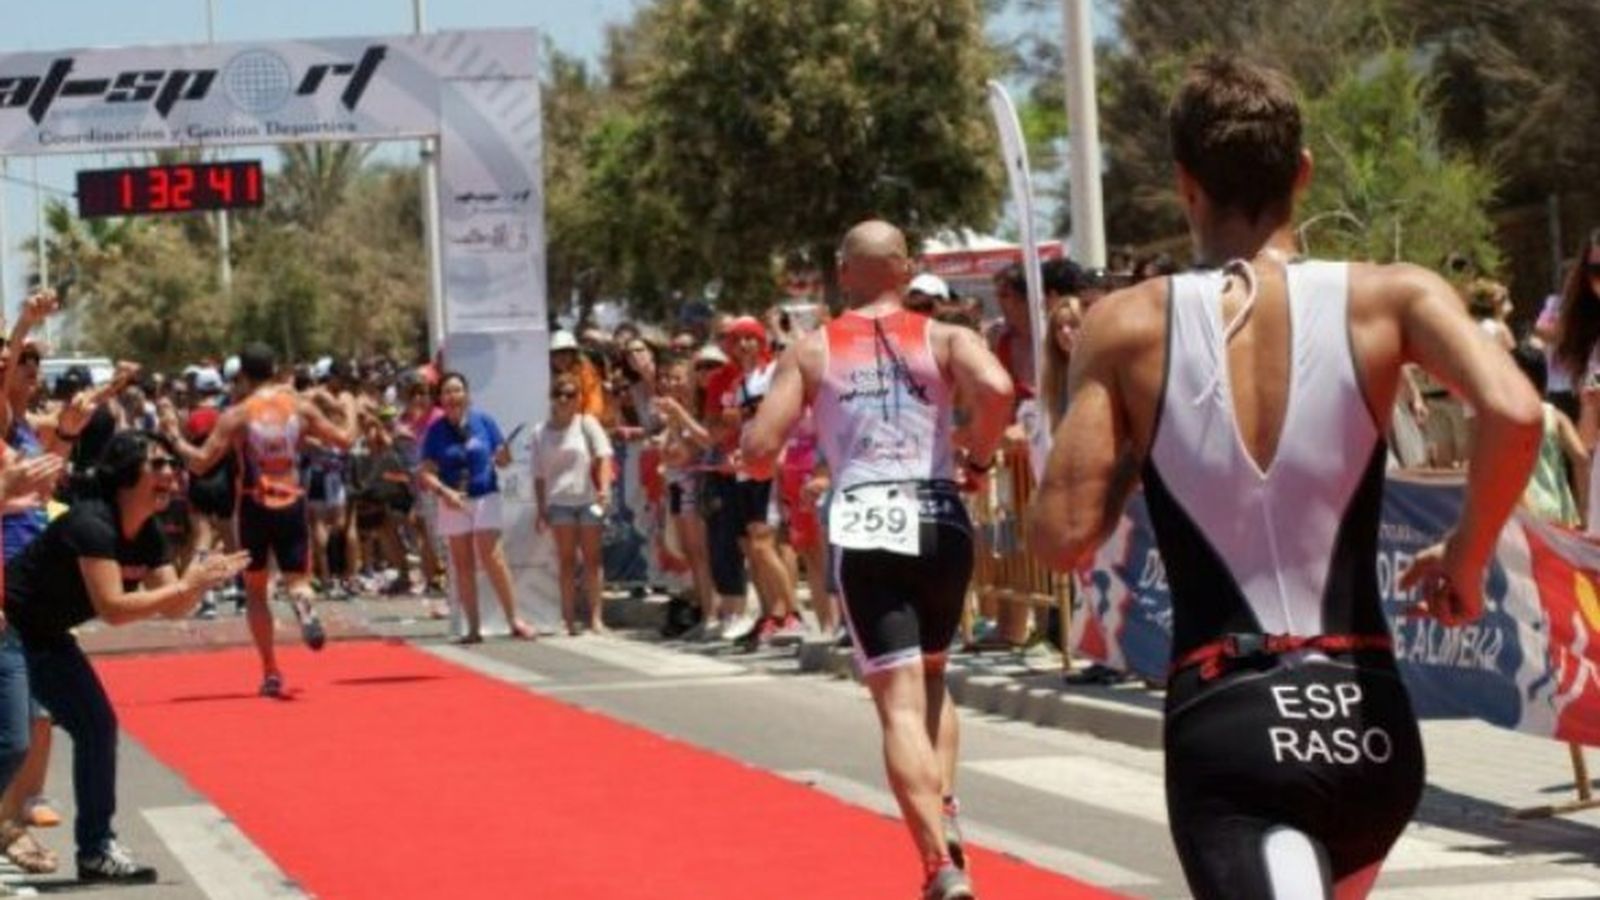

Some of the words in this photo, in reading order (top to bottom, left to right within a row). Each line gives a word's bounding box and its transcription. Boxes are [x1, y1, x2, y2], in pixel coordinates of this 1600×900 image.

[840, 506, 908, 534] 259
[1270, 683, 1363, 720] ESP
[1268, 726, 1392, 764] RASO
